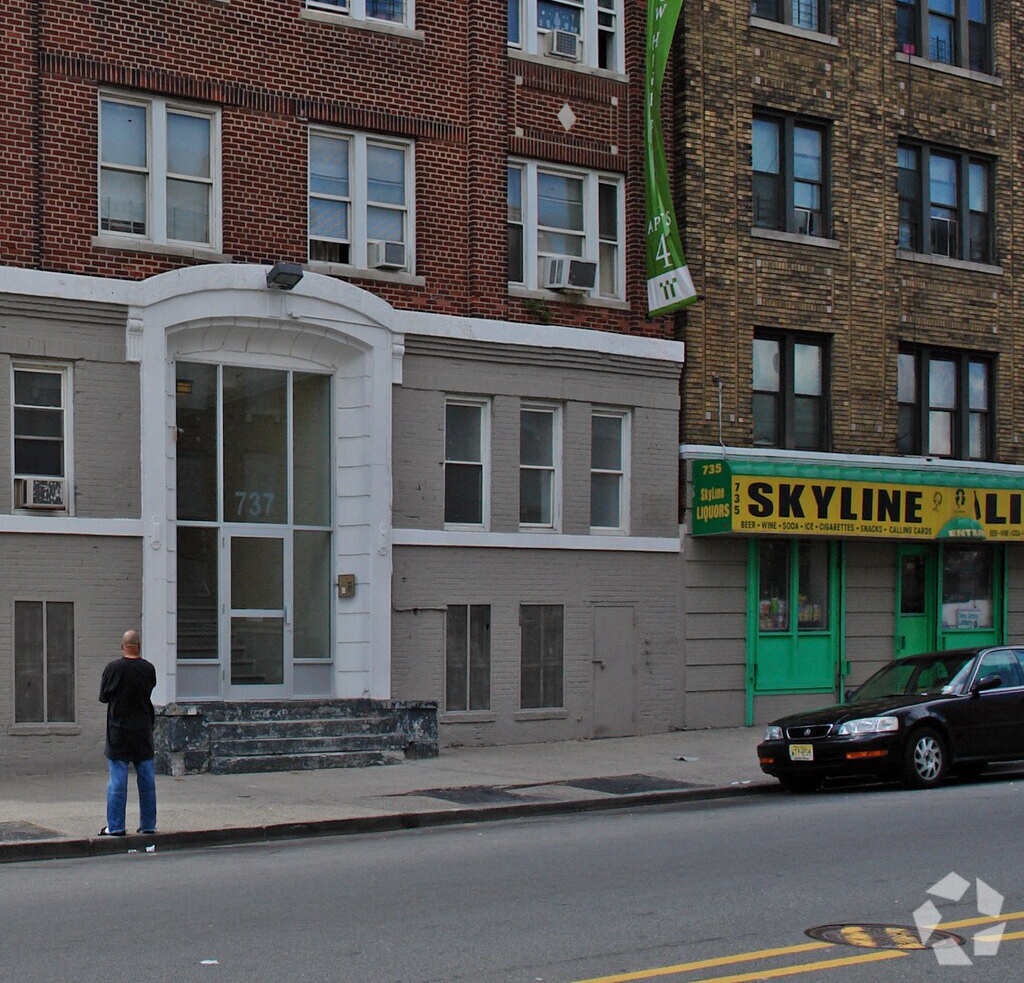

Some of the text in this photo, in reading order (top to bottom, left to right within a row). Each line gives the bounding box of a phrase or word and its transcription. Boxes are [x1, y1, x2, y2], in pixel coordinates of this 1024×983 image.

[655, 233, 673, 268] 4
[702, 463, 722, 475] 735
[235, 491, 274, 517] 737
[696, 503, 730, 523] LIQUORS
[747, 482, 923, 524] SKYLINE
[740, 520, 932, 535] BEER WINE SODA ICE CIGARETTES SNACKS CALLING CARDS
